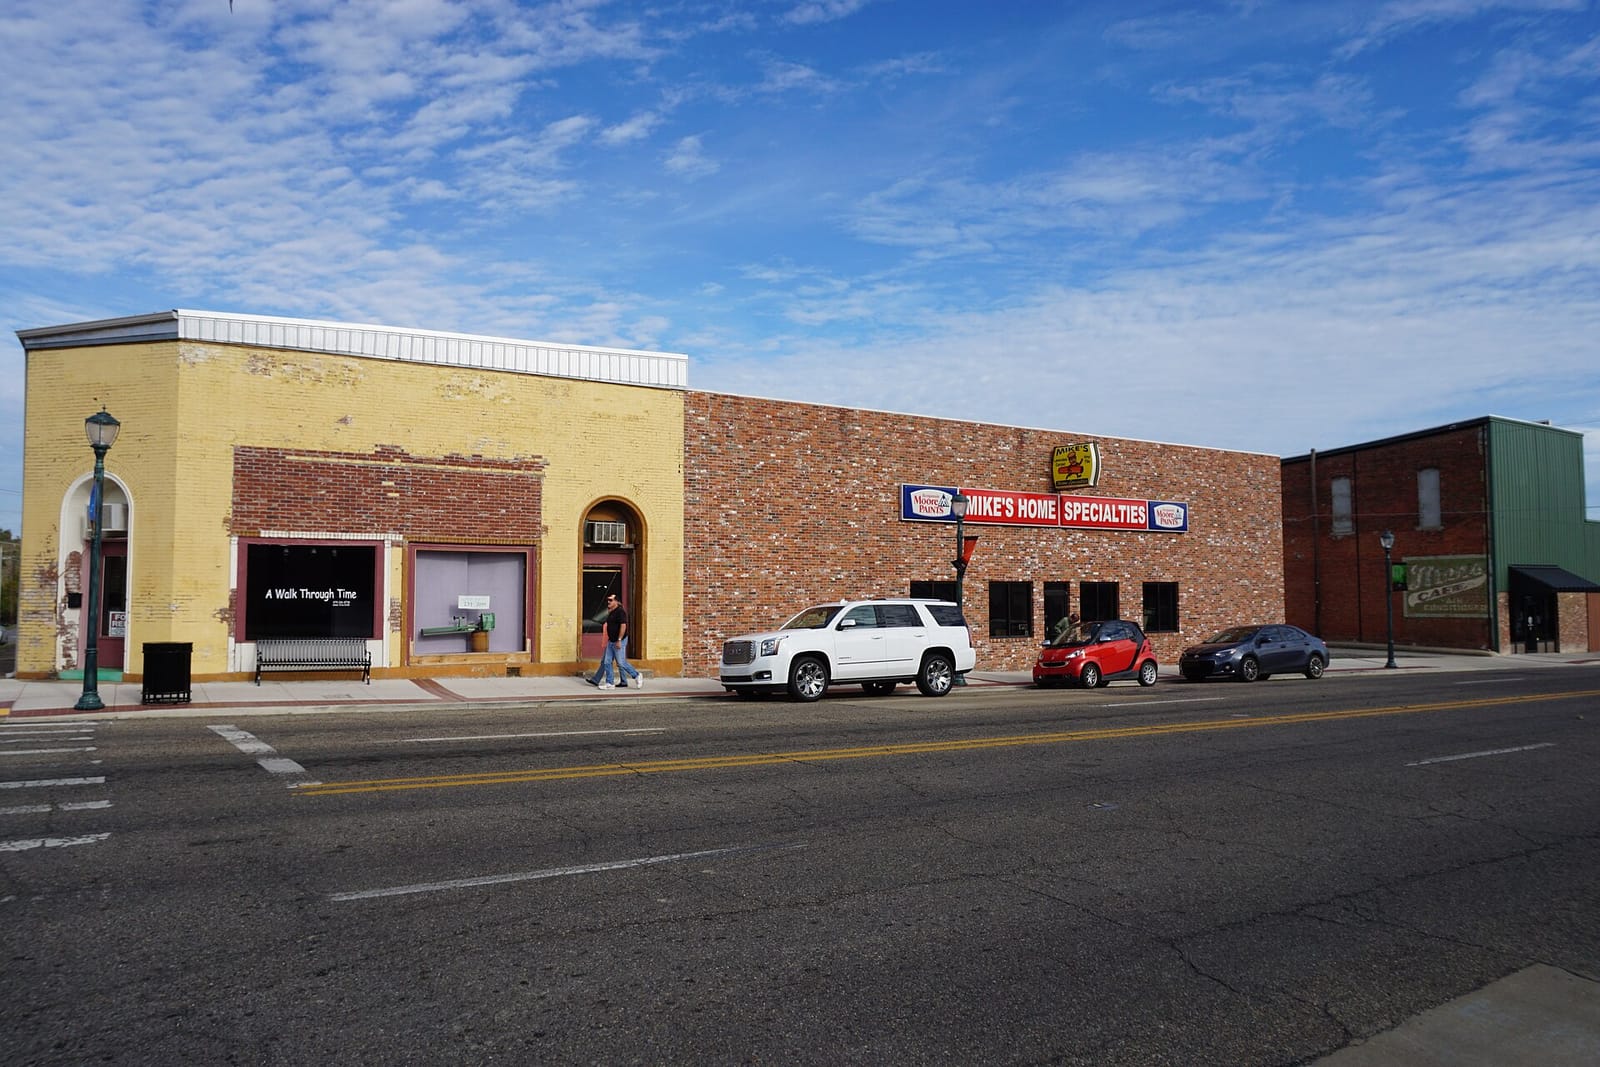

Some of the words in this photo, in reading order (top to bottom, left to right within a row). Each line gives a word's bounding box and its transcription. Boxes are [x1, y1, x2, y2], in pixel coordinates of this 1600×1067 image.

[1056, 445, 1089, 456] MIKE'S
[913, 495, 938, 505] Moore
[919, 505, 944, 513] PAINTS
[966, 495, 1014, 518] MIKE'S
[1018, 498, 1056, 520] HOME
[1064, 501, 1146, 524] SPECIALTIES
[1156, 509, 1175, 518] Moore
[1160, 517, 1178, 525] PAINTS
[265, 588, 273, 599] A
[274, 588, 298, 599] Walk
[299, 588, 335, 602] Through
[336, 588, 357, 599] Time
[114, 612, 126, 621] FO
[112, 620, 125, 628] RE
